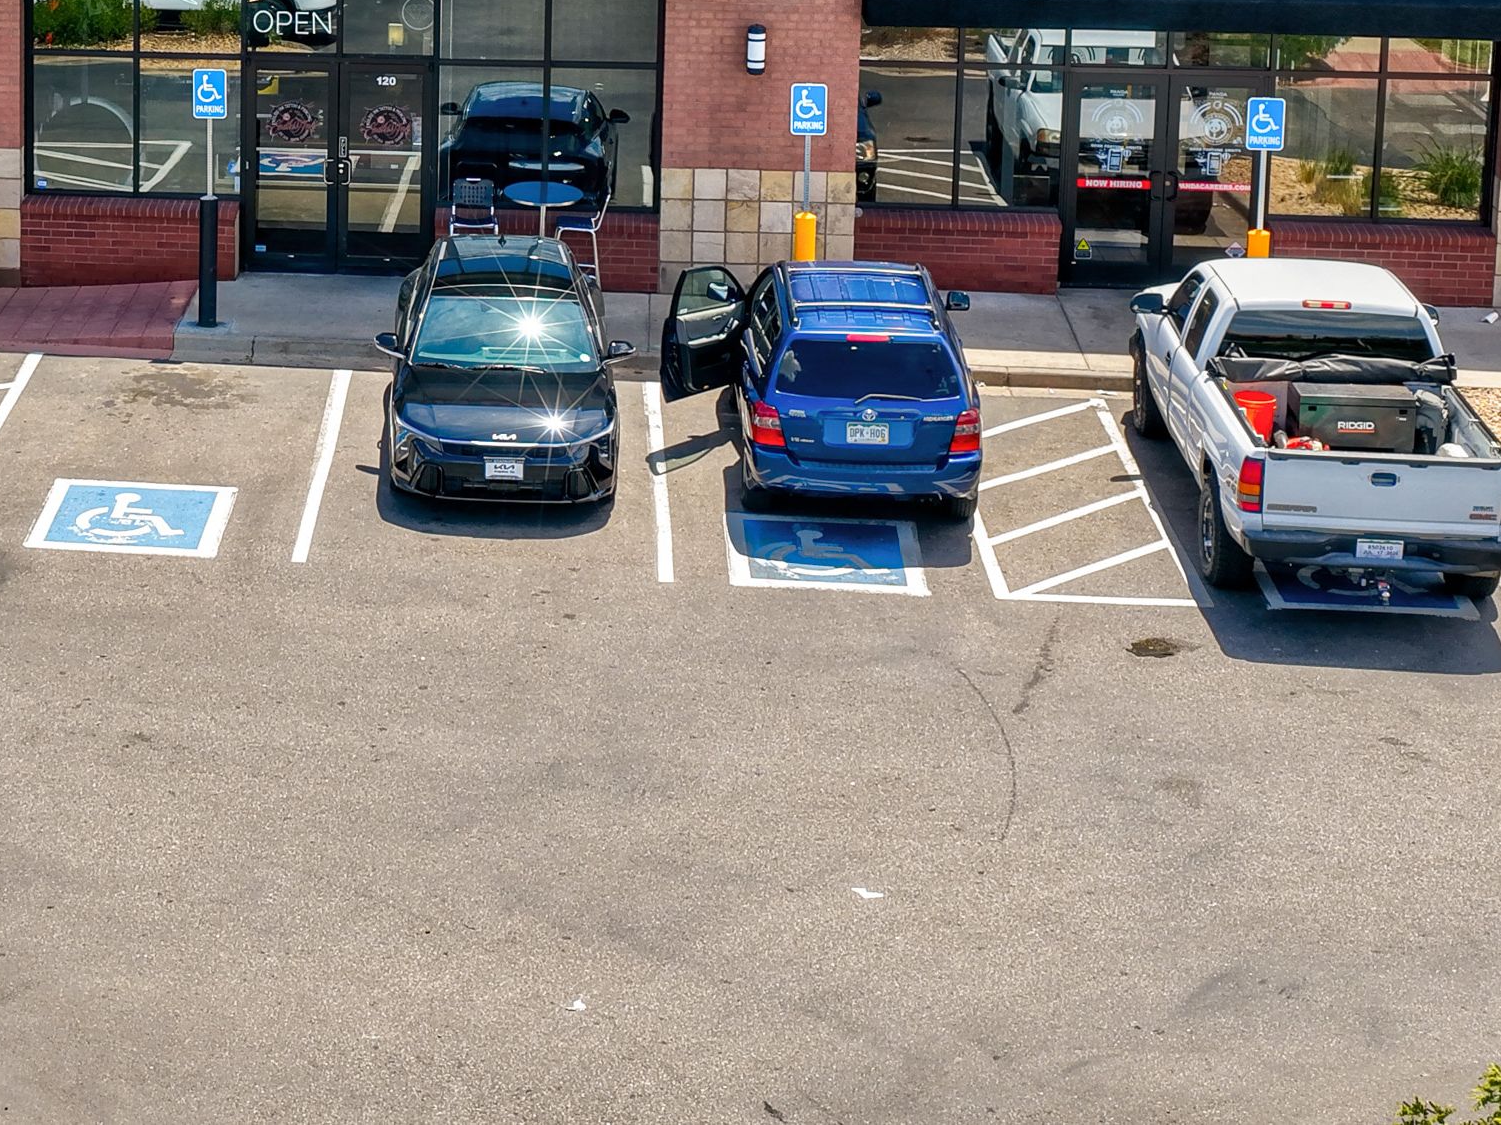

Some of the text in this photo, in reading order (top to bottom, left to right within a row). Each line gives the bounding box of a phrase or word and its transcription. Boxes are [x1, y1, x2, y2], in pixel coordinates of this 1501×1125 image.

[253, 10, 332, 35] OPEN
[376, 76, 397, 86] 120
[196, 105, 224, 114] PARKING
[794, 121, 824, 130] PARKING
[1250, 136, 1280, 145] PARKING
[1085, 179, 1142, 189] NOW HIRING
[1337, 421, 1376, 430] RIDGID
